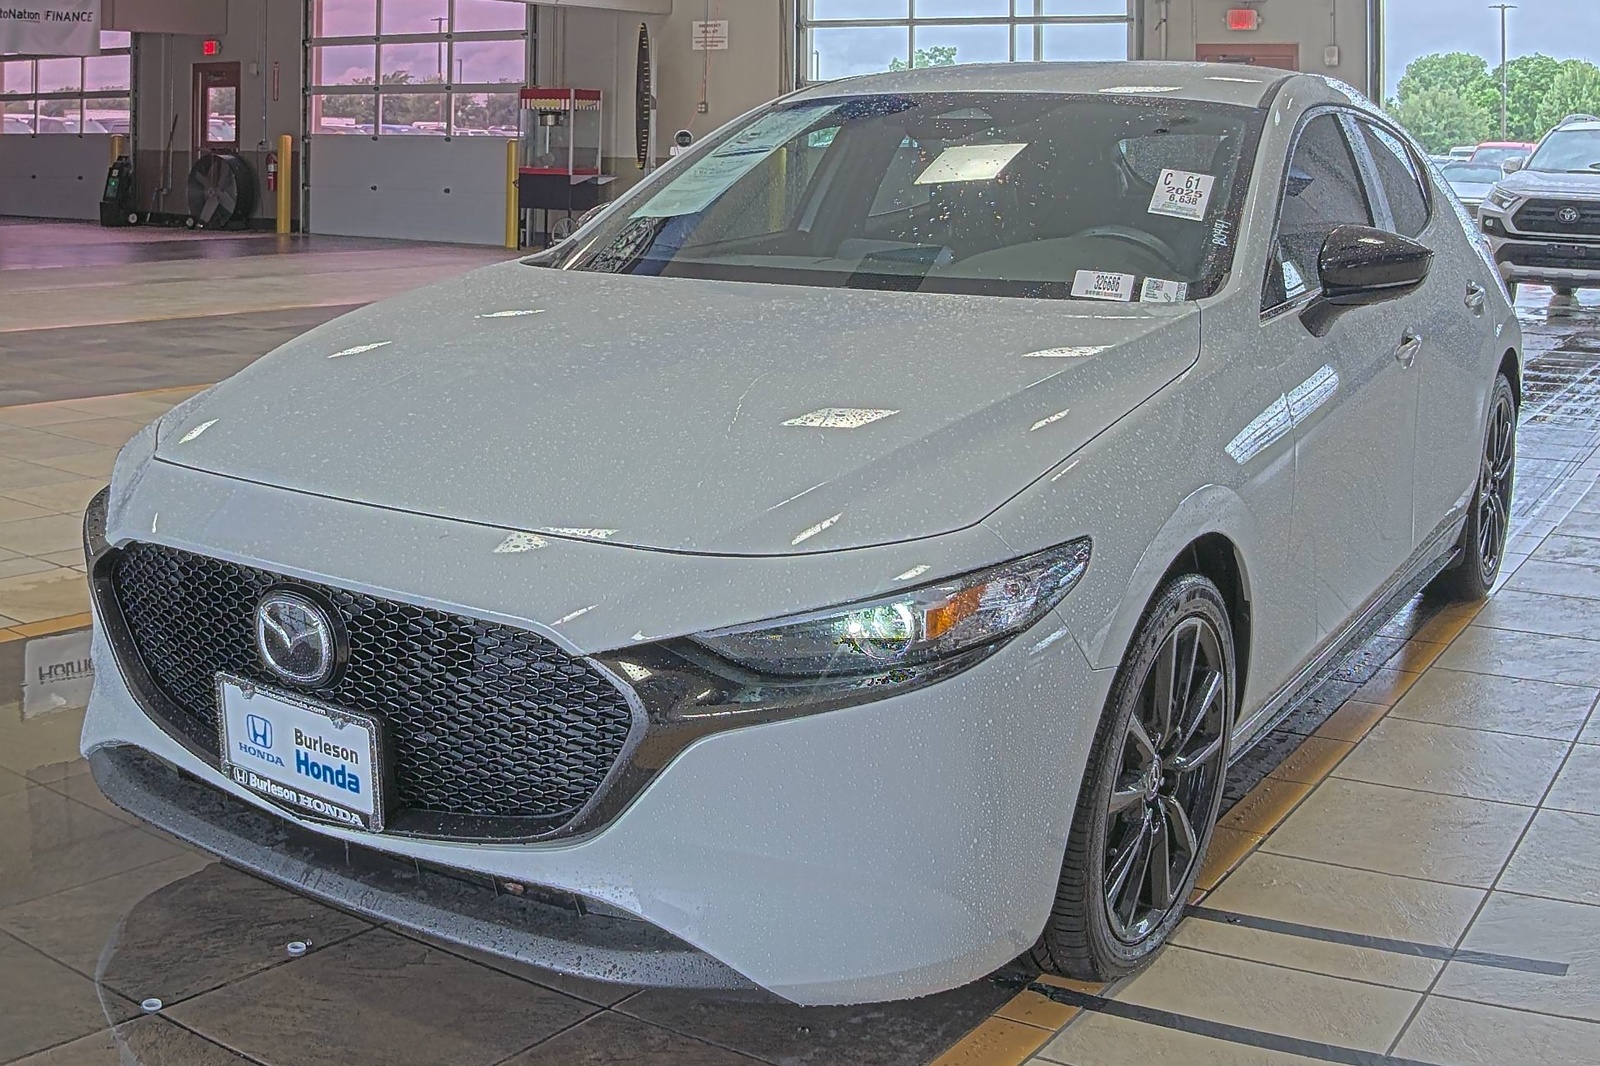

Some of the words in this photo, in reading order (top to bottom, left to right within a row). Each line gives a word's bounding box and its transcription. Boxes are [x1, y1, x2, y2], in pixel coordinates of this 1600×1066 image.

[45, 11, 94, 22] FINANCE
[1164, 172, 1173, 186] C
[1185, 175, 1201, 190] 61
[1165, 186, 1203, 198] 2025
[1168, 193, 1198, 205] 6.638
[254, 685, 327, 715] burlesonhonda.com
[238, 742, 285, 767] HONDA
[294, 728, 359, 764] Burleson
[295, 749, 360, 794] Honda
[249, 772, 297, 802] Burleson
[298, 793, 365, 828] HONDA
